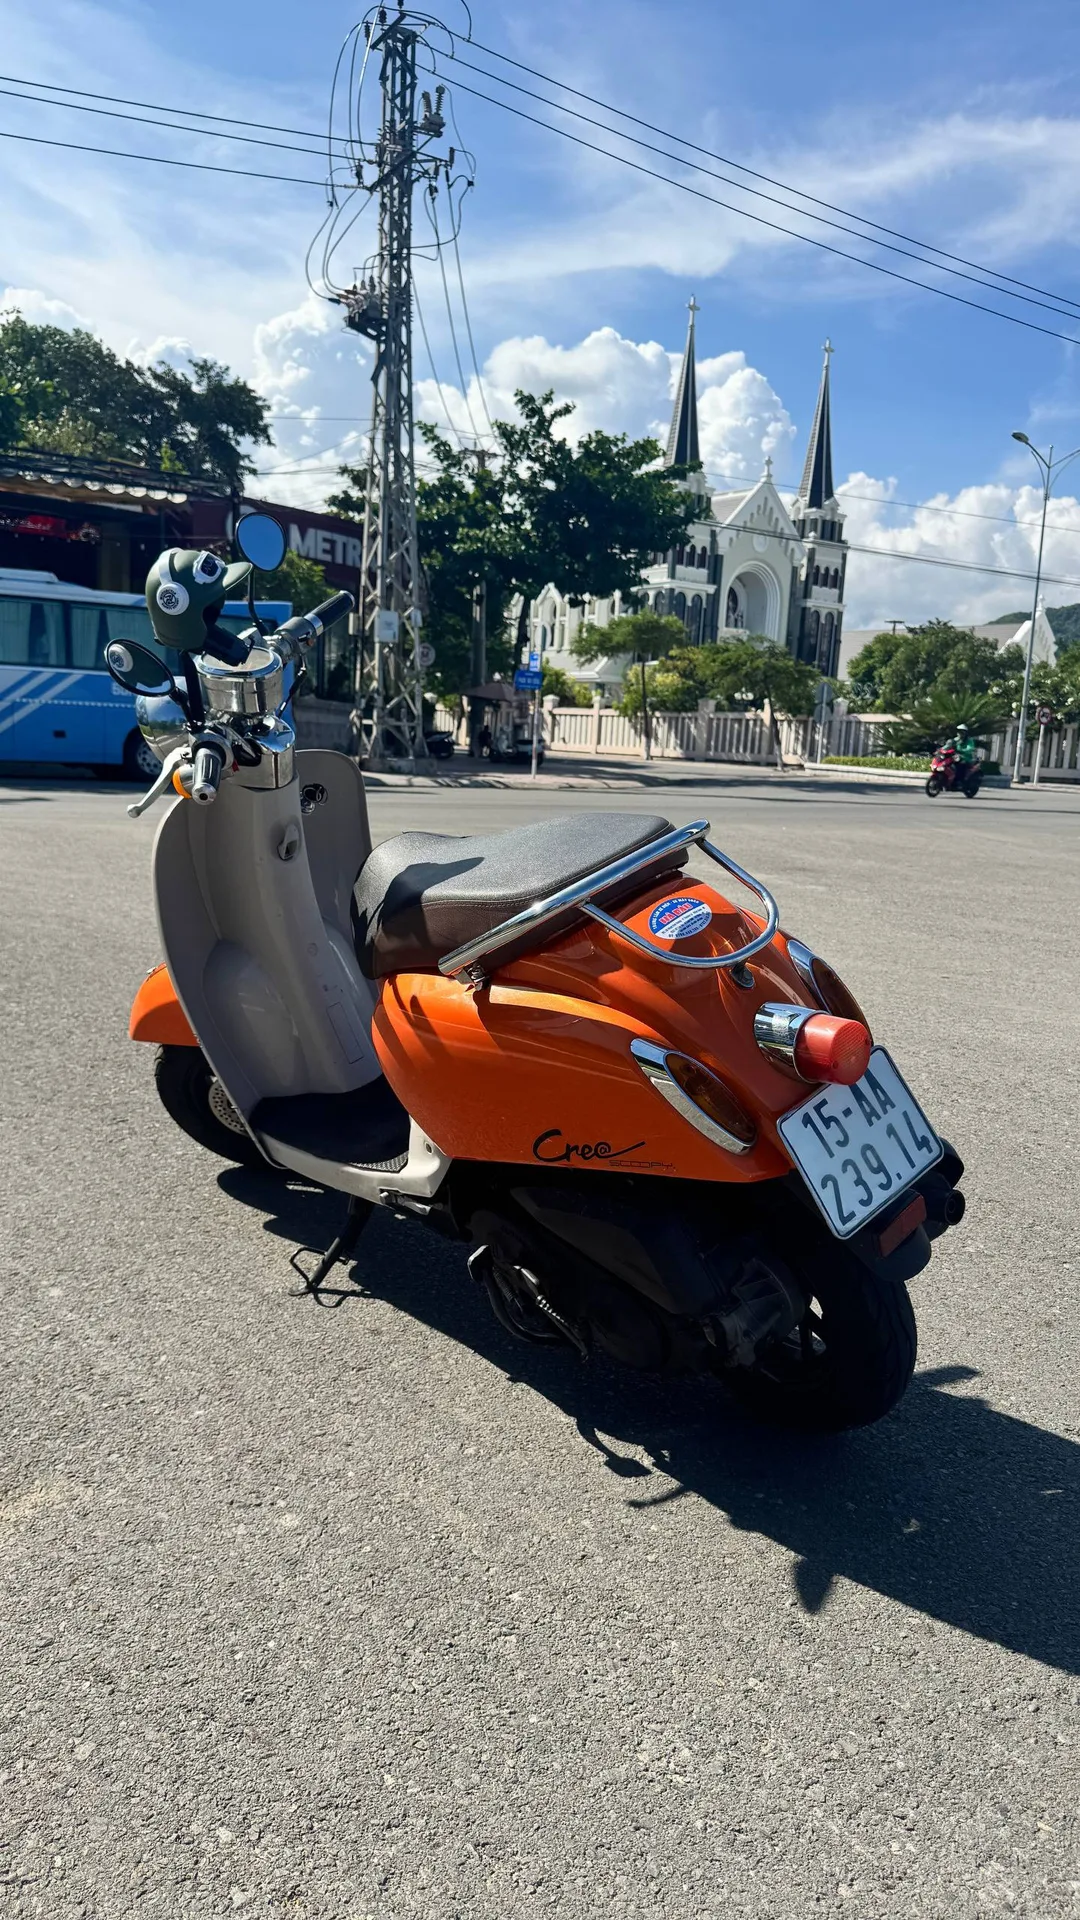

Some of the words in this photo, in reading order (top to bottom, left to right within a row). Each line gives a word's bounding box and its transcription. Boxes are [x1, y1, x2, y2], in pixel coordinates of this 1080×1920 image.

[289, 523, 378, 571] METR
[801, 1067, 897, 1159] 15-AA
[820, 1110, 934, 1227] 239.14
